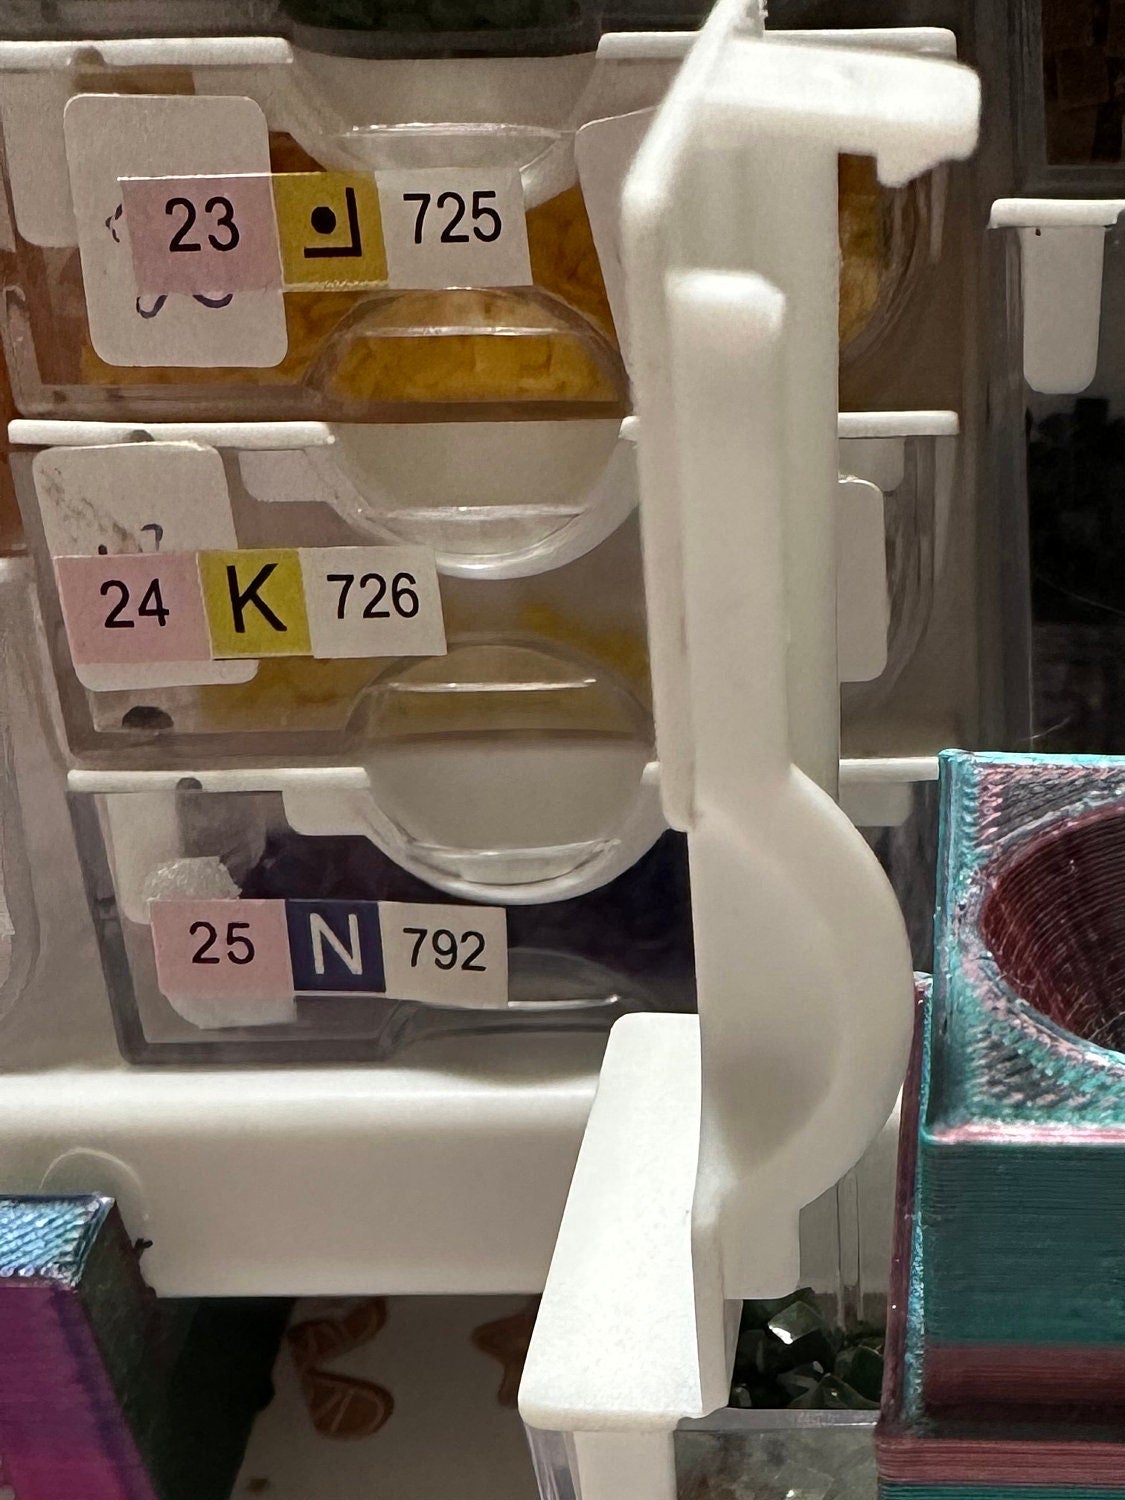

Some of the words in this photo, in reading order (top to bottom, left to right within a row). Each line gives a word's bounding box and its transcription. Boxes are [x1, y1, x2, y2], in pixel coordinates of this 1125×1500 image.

[164, 196, 241, 252] 23
[402, 190, 503, 244] 725
[99, 577, 170, 629] 24
[226, 562, 288, 634] K
[326, 572, 420, 620] 726
[188, 921, 256, 966] 25
[308, 912, 363, 976] N
[402, 927, 488, 972] 792
